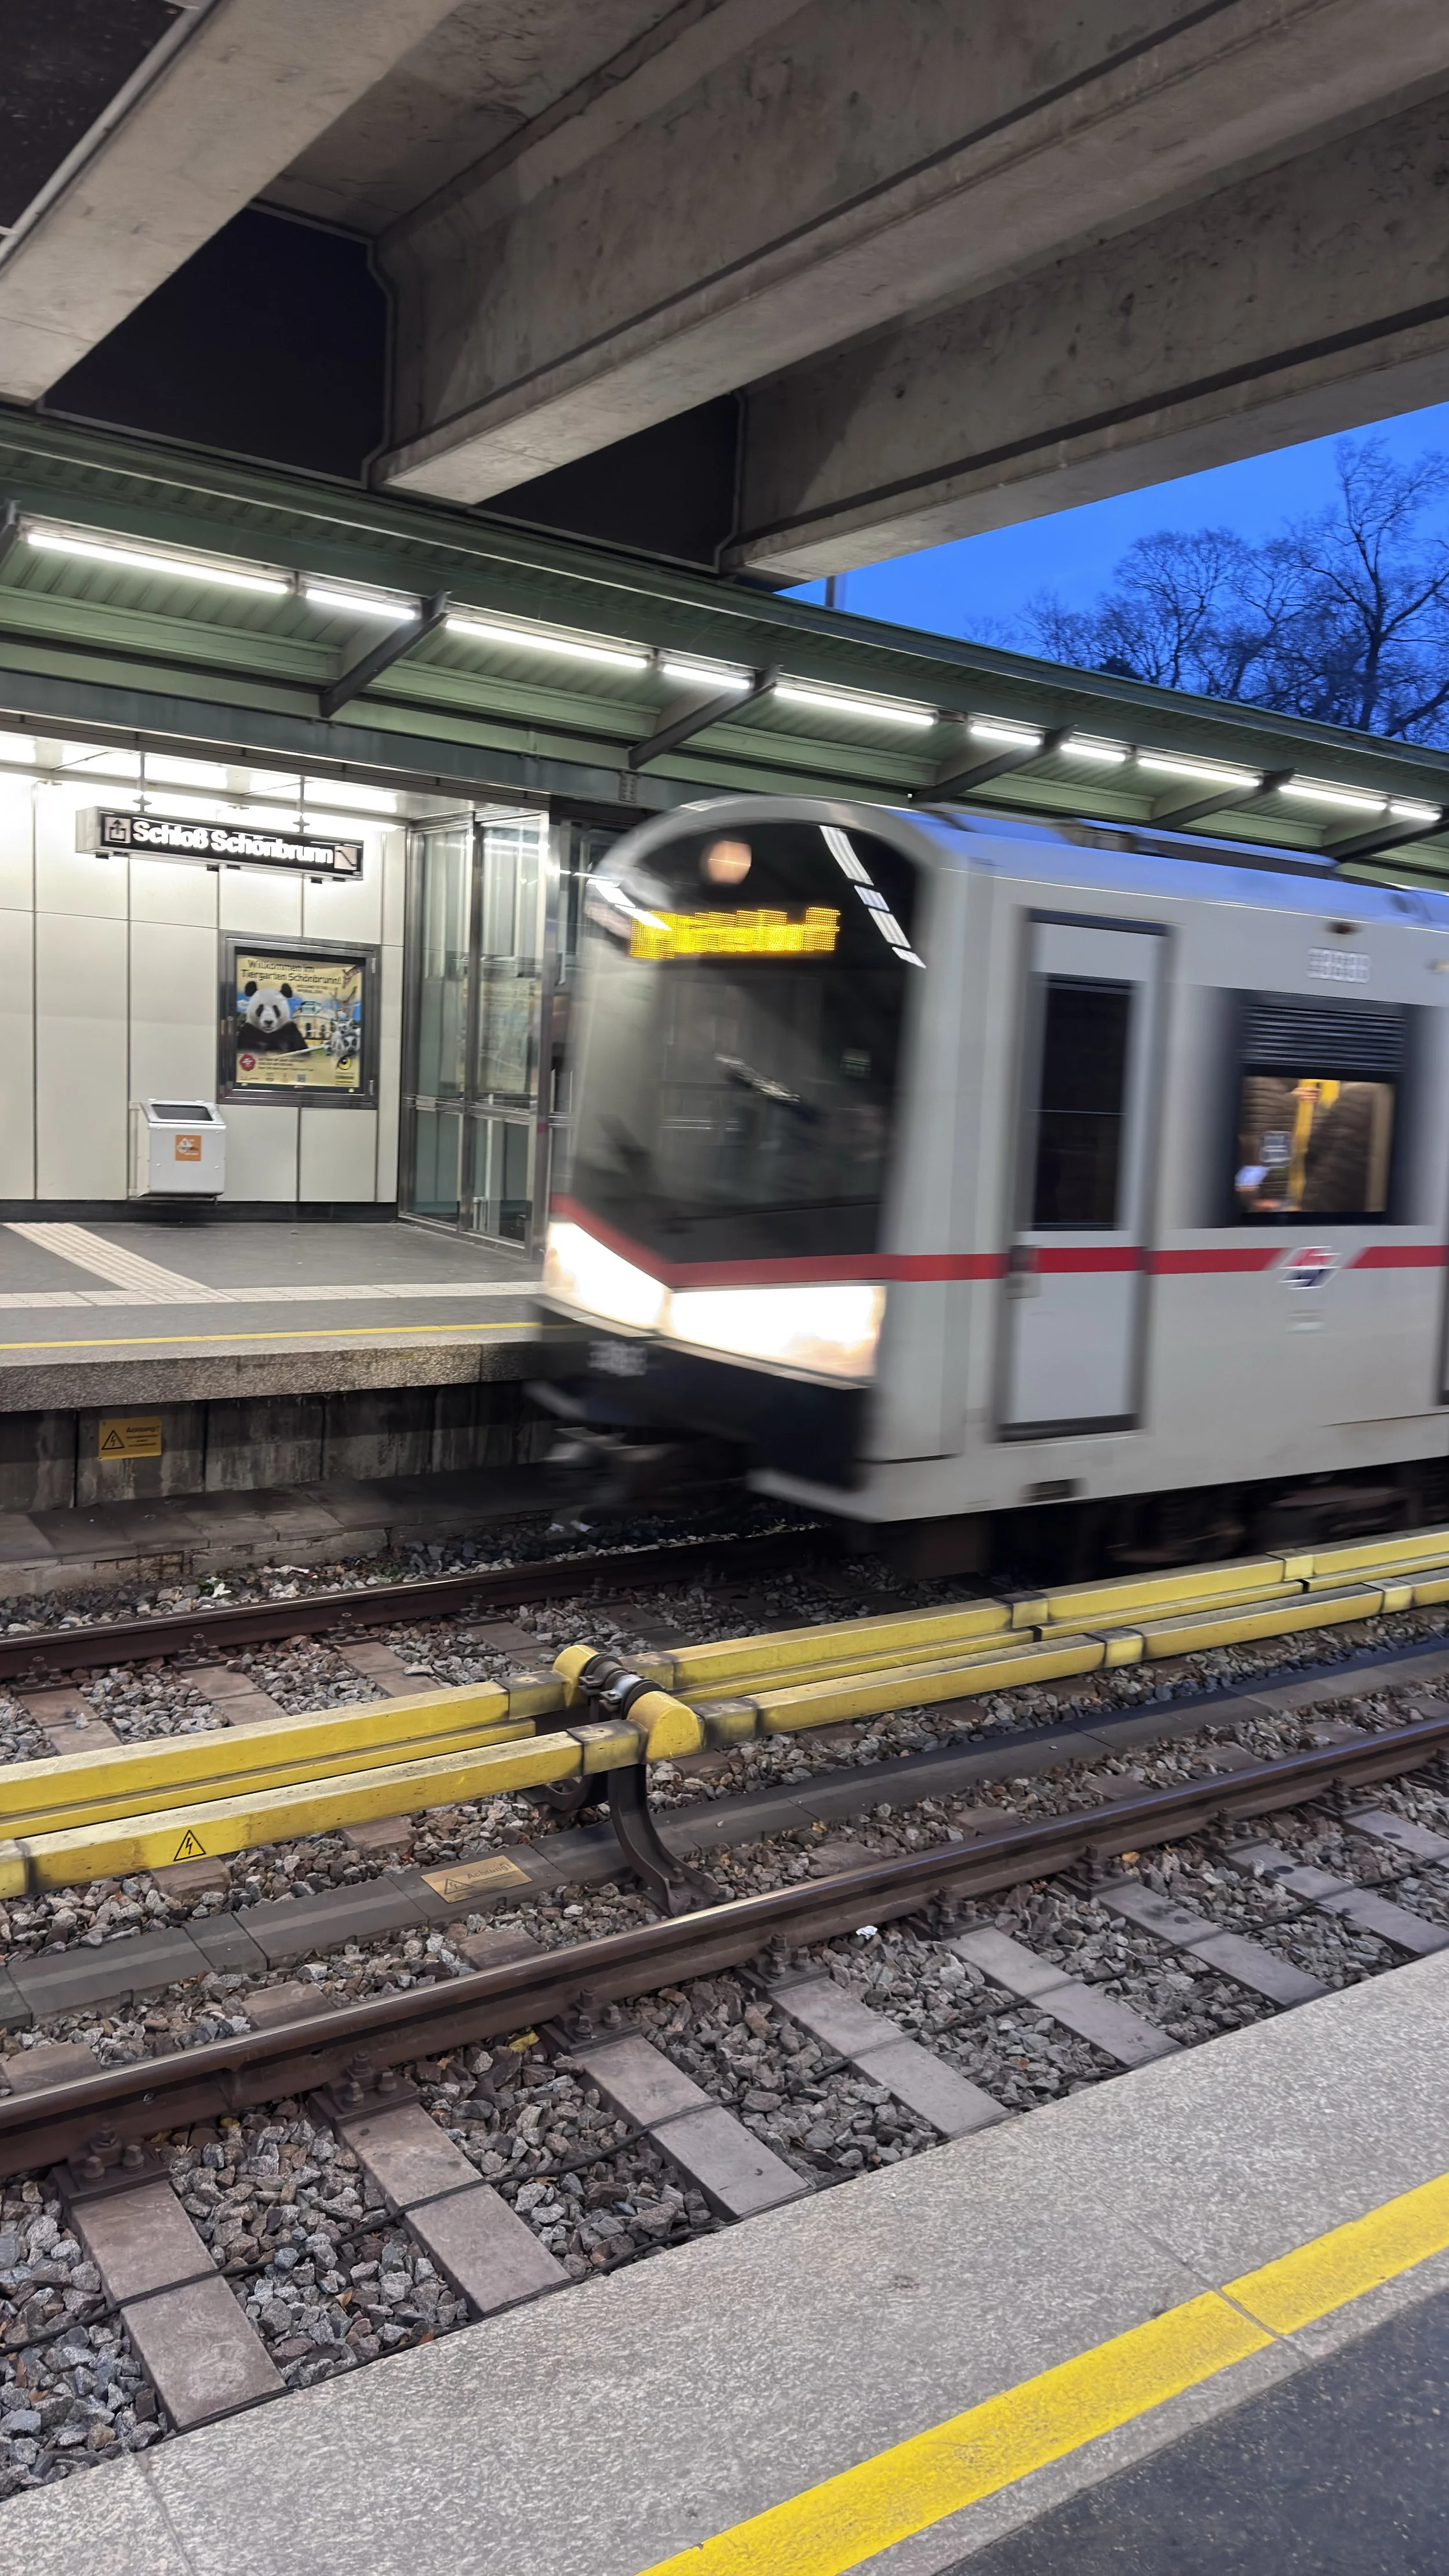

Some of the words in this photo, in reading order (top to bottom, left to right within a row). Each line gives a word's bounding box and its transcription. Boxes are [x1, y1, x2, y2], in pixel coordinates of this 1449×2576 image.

[133, 821, 209, 849] Schloß
[210, 830, 333, 864] Schönbrunn
[247, 959, 302, 972] Willkommen
[303, 964, 315, 973] im
[241, 969, 287, 981] Tiergarten
[467, 1862, 512, 1879] Achtung!
